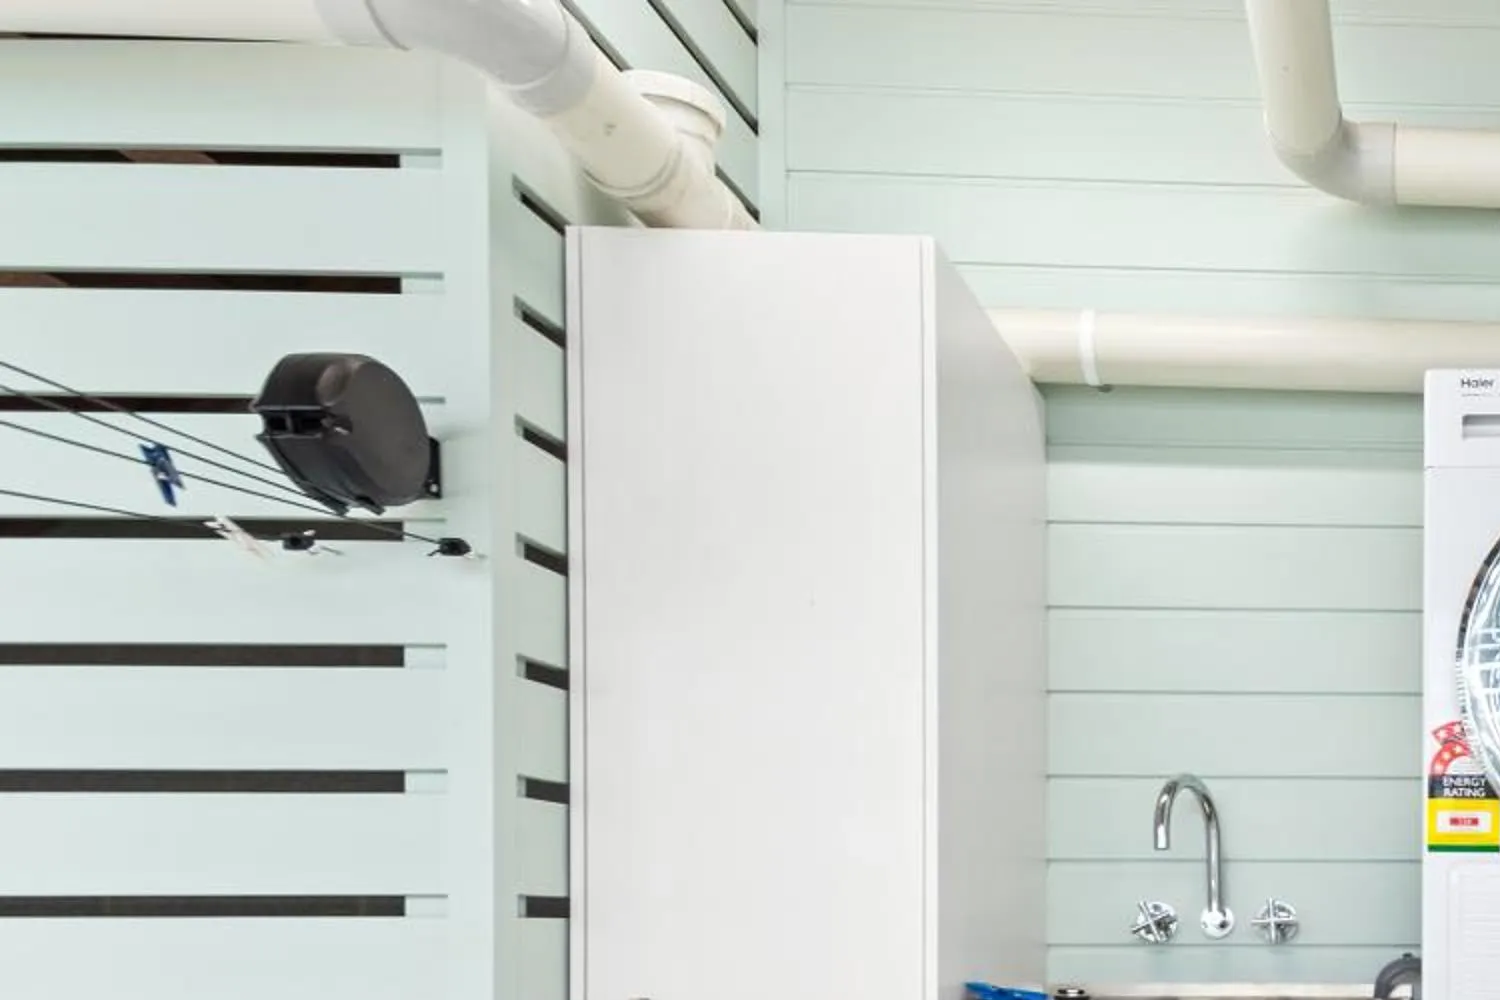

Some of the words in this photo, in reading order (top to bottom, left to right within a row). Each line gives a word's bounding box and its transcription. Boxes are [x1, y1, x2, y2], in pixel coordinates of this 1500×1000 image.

[1460, 378, 1495, 389] Haier
[1442, 776, 1486, 787] ENERGY
[1443, 787, 1486, 797] RATING
